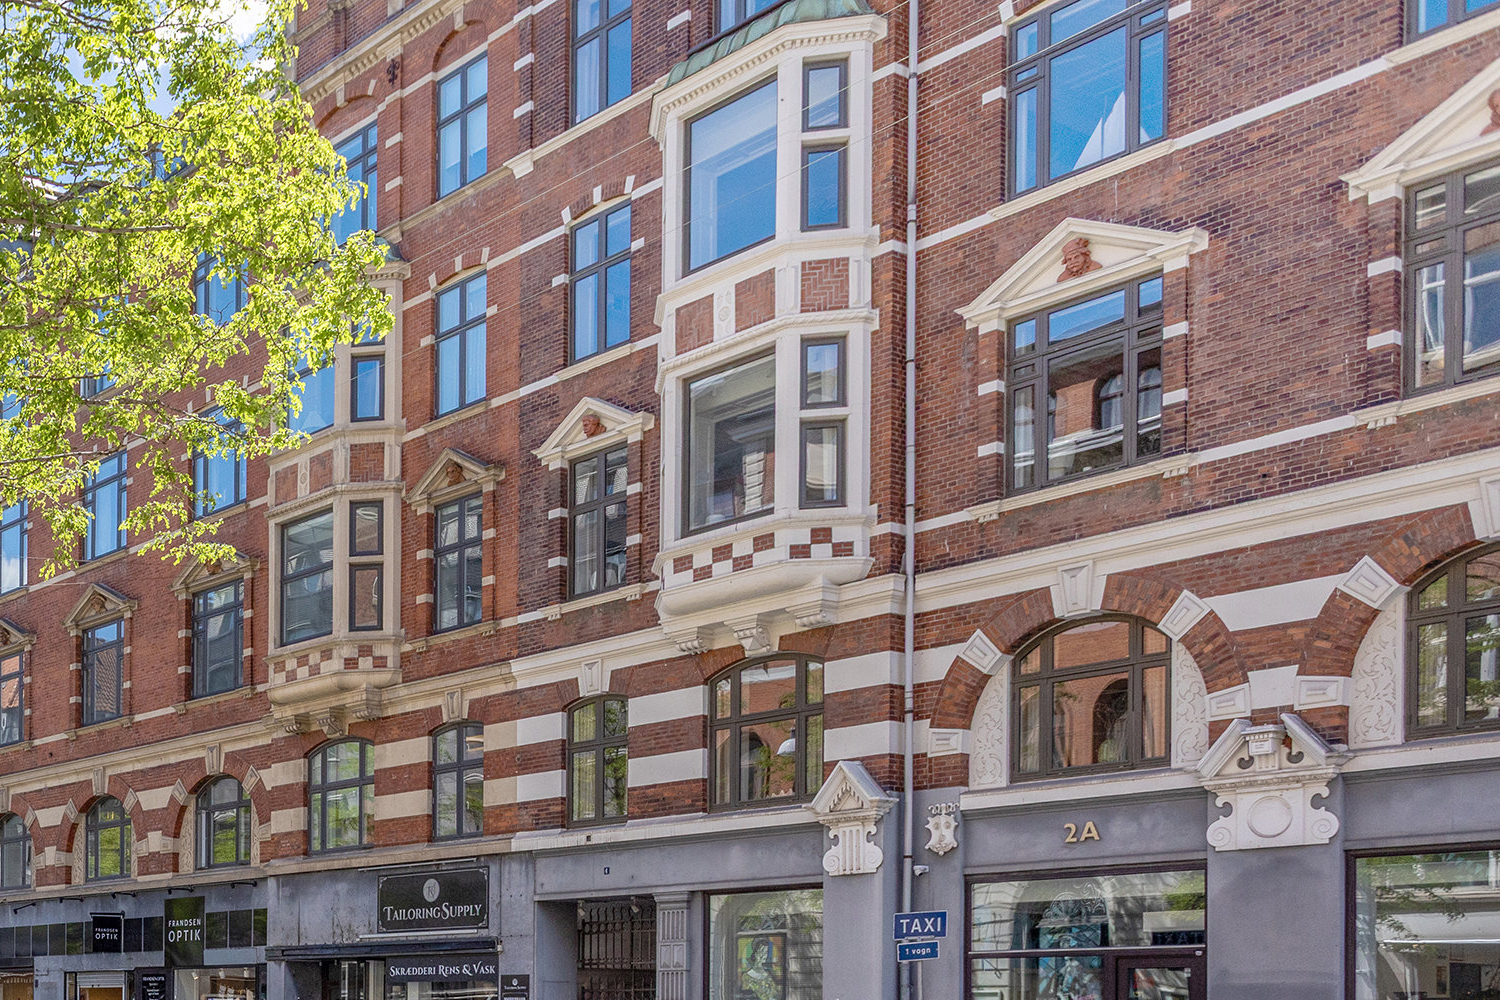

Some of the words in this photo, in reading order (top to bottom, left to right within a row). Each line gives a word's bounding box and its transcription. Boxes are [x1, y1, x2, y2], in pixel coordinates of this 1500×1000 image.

[1063, 821, 1100, 842] 2A
[168, 918, 201, 927] FRANDSEN
[900, 917, 941, 933] TAXI
[168, 929, 201, 942] OPTIK
[390, 966, 436, 977] SKRÆDDERI
[438, 965, 460, 977] RENS
[462, 964, 473, 976] &
[473, 961, 495, 974] VASK
